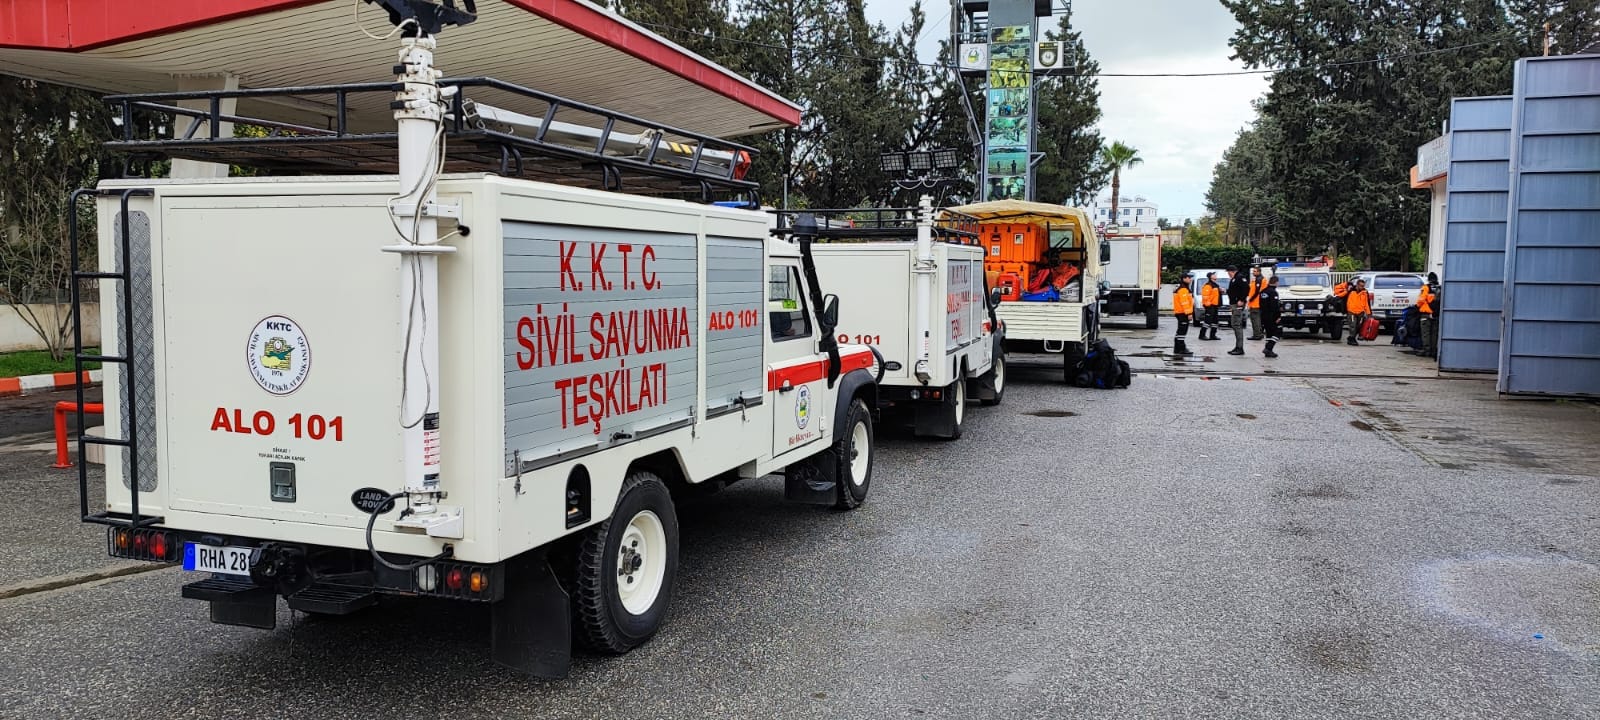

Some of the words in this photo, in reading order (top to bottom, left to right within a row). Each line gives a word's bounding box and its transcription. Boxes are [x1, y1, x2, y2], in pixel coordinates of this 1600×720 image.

[559, 241, 583, 292] K.
[590, 242, 612, 291] K.
[618, 243, 635, 291] T.
[641, 244, 661, 291] C.
[266, 321, 292, 332] KKTC
[708, 311, 735, 331] ALO
[738, 309, 758, 328] 101
[516, 302, 584, 371] SİVİL
[589, 307, 691, 361] SAVUNMA
[854, 334, 880, 345] 101
[555, 358, 667, 435] TEŞKİLATI
[210, 407, 276, 436] ALO
[288, 413, 343, 442] 101
[200, 548, 227, 570] RHA
